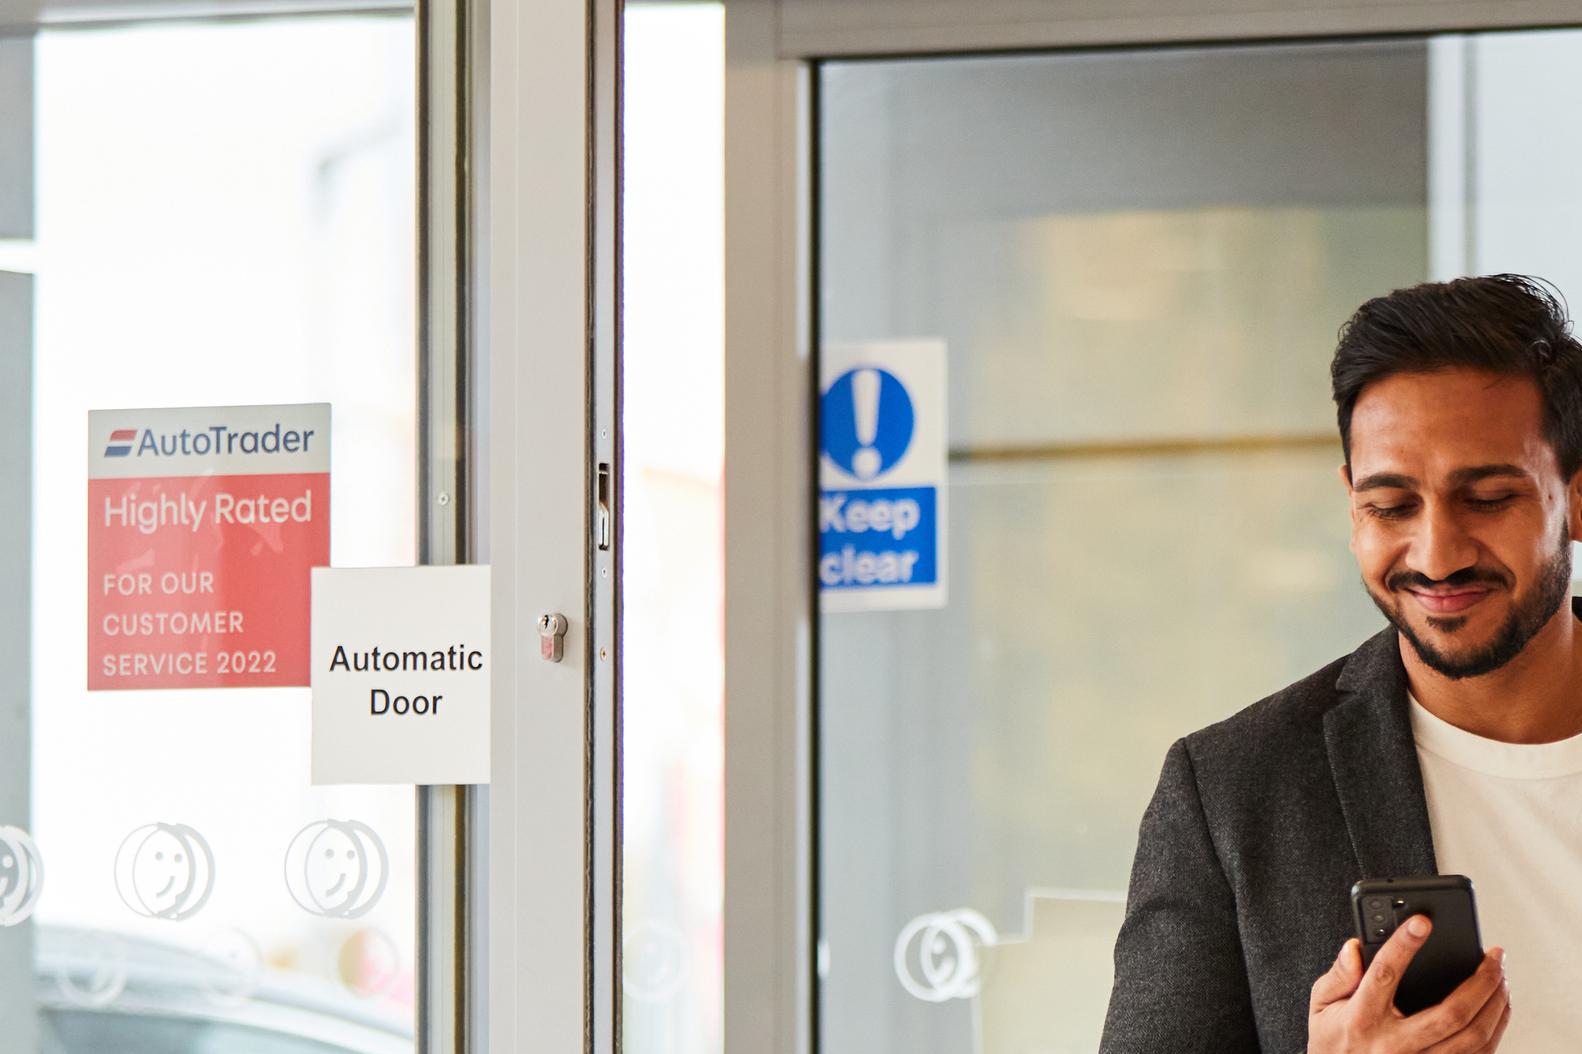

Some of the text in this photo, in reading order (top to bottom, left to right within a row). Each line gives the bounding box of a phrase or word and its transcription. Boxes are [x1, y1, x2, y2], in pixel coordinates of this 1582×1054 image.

[137, 423, 315, 457] AutoTrader
[104, 490, 312, 533] Highly Rated
[820, 493, 920, 540] Keep
[820, 544, 918, 585] clear
[103, 572, 214, 596] FOR OUR
[103, 612, 245, 636] CUSTOMER
[103, 651, 277, 677] SERVICE 2022
[330, 644, 484, 672] Automatic
[370, 689, 443, 716] Door
